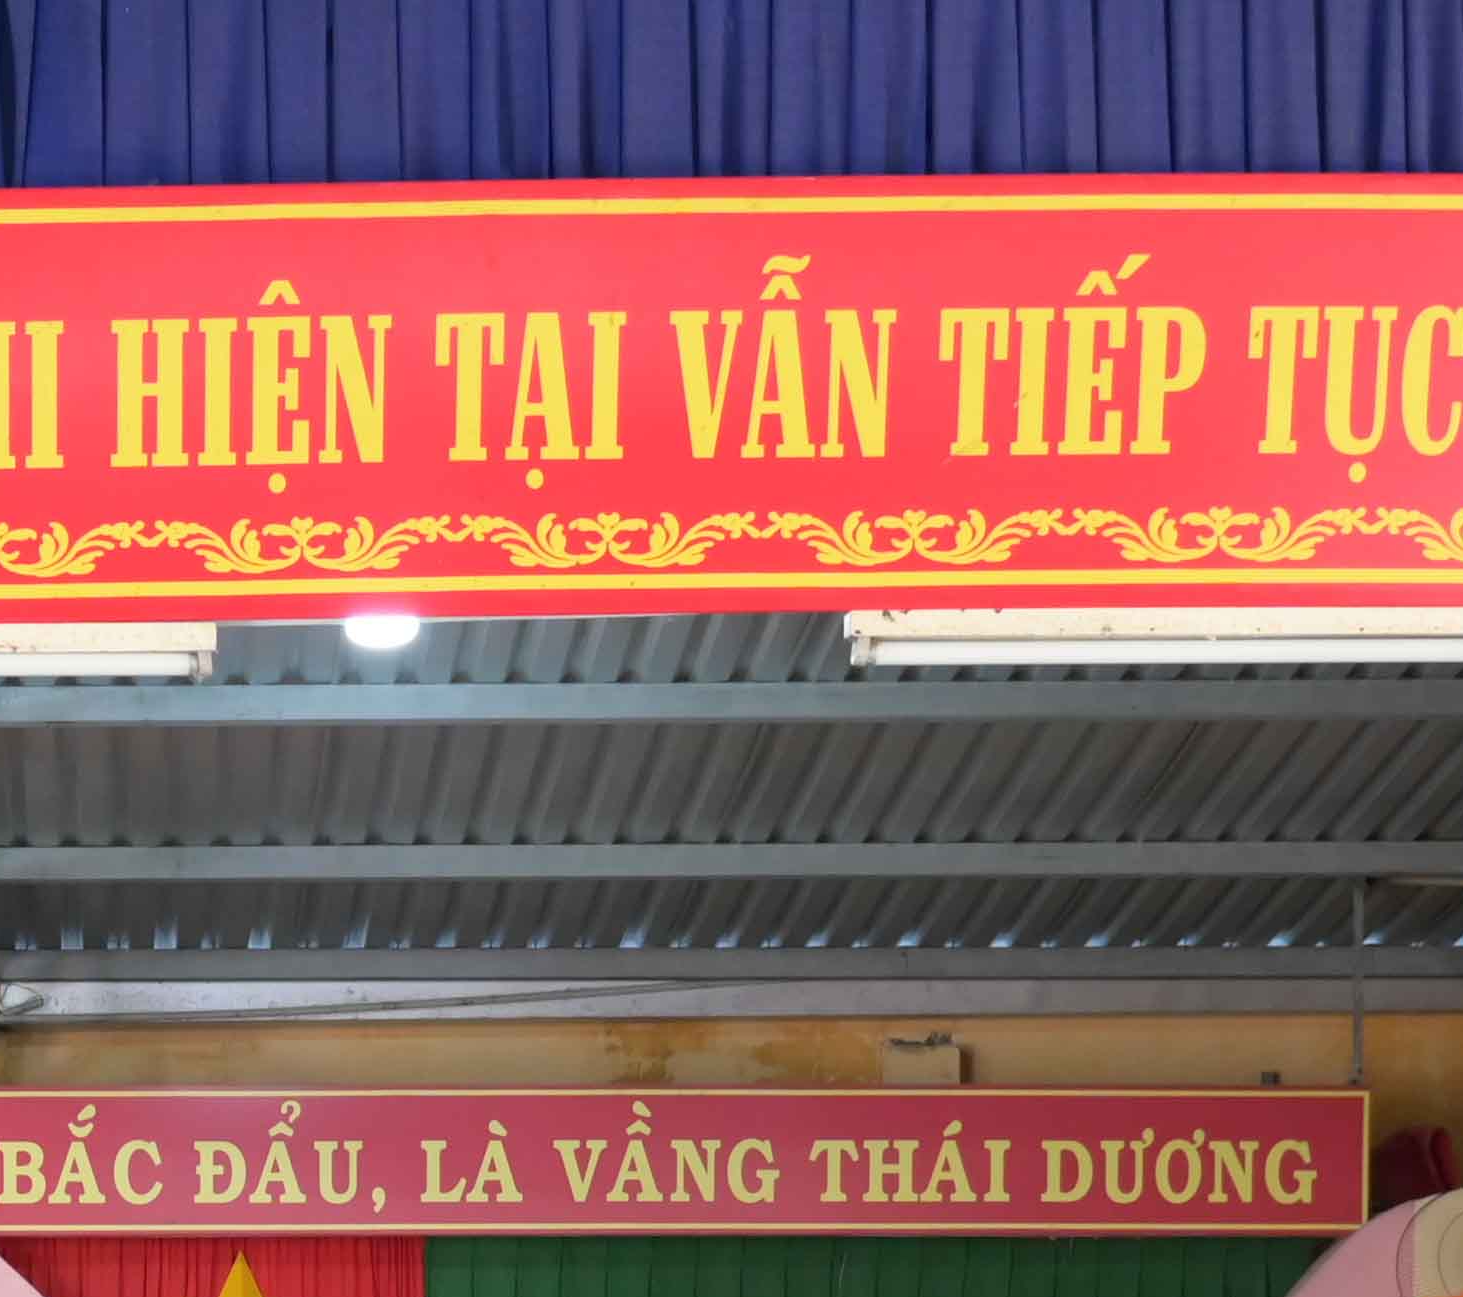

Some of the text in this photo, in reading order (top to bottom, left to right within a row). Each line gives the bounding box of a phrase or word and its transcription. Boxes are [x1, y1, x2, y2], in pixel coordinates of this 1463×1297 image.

[111, 280, 392, 493] HIỆN
[436, 312, 627, 489] TẠI
[670, 256, 897, 458] VẪN
[939, 254, 1206, 455] TIẾP
[194, 1100, 385, 1212] ĐẨU,
[421, 1120, 523, 1202] LÀ
[554, 1101, 780, 1203] VẦNG
[809, 1120, 1011, 1202] THÁI
[1041, 1128, 1317, 1204] DƯƠNG
